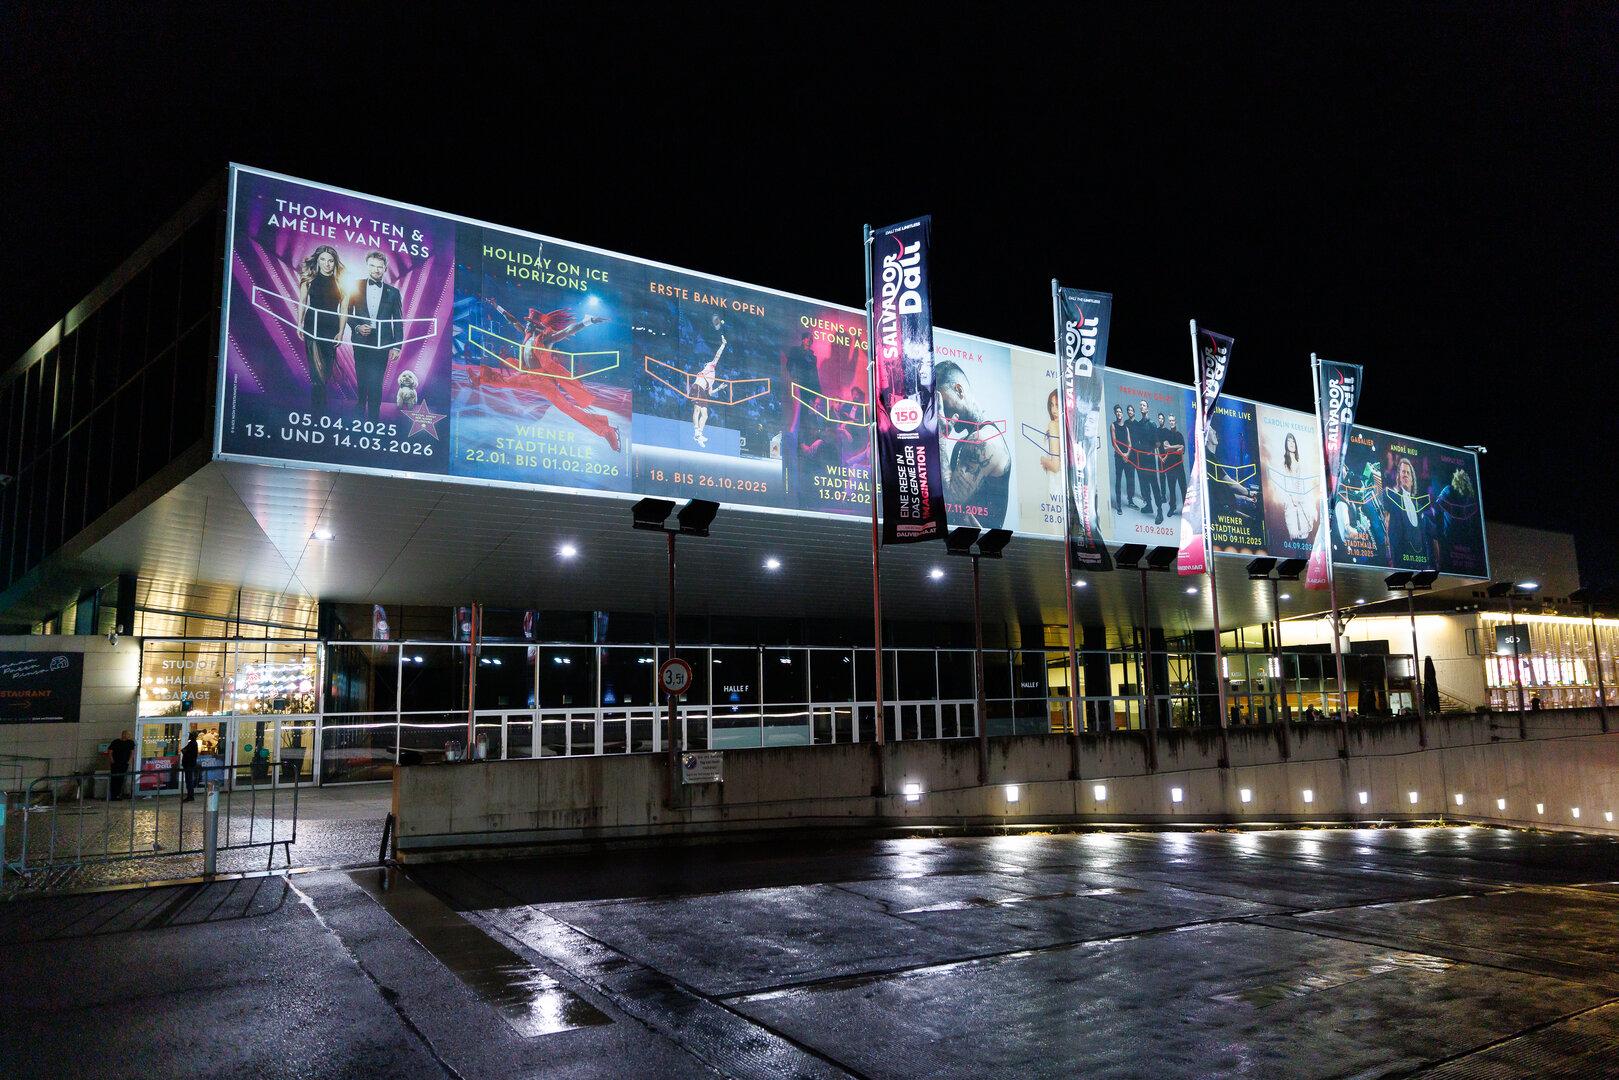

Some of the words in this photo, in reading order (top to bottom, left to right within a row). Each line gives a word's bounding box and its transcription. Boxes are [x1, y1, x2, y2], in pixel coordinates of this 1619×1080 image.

[275, 198, 363, 229] THOMMY
[370, 219, 404, 239] TEN
[411, 229, 424, 242] &
[267, 212, 337, 239] AMÉLIE
[344, 229, 381, 249] VAN
[388, 239, 430, 258] TASS
[483, 245, 552, 270] HOLIDAY
[557, 262, 580, 276] ON
[586, 268, 609, 282] ICE
[506, 264, 588, 291] HORIZONS
[650, 282, 688, 300] ERSTE
[693, 292, 727, 309] BANK
[732, 301, 765, 317] OPEN
[881, 253, 902, 359] SALVADOR
[800, 315, 845, 334] QUEENS
[848, 327, 862, 337] OF
[813, 330, 850, 346] STONE
[854, 339, 869, 350] AG
[936, 346, 974, 361] KONTRA
[977, 355, 983, 363] K
[288, 411, 398, 437] 05.04.2025
[895, 411, 918, 422] 150
[1214, 406, 1237, 418] IMMER
[1238, 412, 1251, 420] LIVE
[1327, 379, 1341, 451] SALVADOR
[245, 423, 271, 439] 13.
[280, 427, 325, 444] UND
[333, 434, 434, 457] 14.03.2026
[515, 424, 576, 442] WIENER
[496, 437, 593, 460] STADTHALLE
[896, 454, 905, 465] IN
[905, 446, 915, 466] DER
[466, 449, 510, 465] 22.01.
[516, 454, 537, 467] BIS
[542, 458, 619, 477] 01.02.2026
[826, 465, 869, 480] WIENER
[650, 469, 668, 482] 18.
[674, 472, 694, 484] BIS
[699, 475, 767, 493] 26.10.2025
[814, 476, 881, 493] STADTHALE
[898, 466, 908, 493] REISE
[908, 467, 919, 495] GENIE
[916, 446, 930, 519] IMAGINATION
[819, 488, 871, 504] 13.07.202
[900, 495, 909, 518] EINE
[911, 497, 920, 519] DAS
[1135, 524, 1174, 536] 21.09.2025
[1211, 523, 1251, 535] STADTHALLE
[1217, 515, 1243, 525] WIENER
[1212, 533, 1228, 542] UND
[1229, 535, 1262, 546] 09.11.2025
[1283, 541, 1312, 550] 04.09.202
[162, 660, 207, 669] STUDIO
[665, 669, 685, 686] 3,5t
